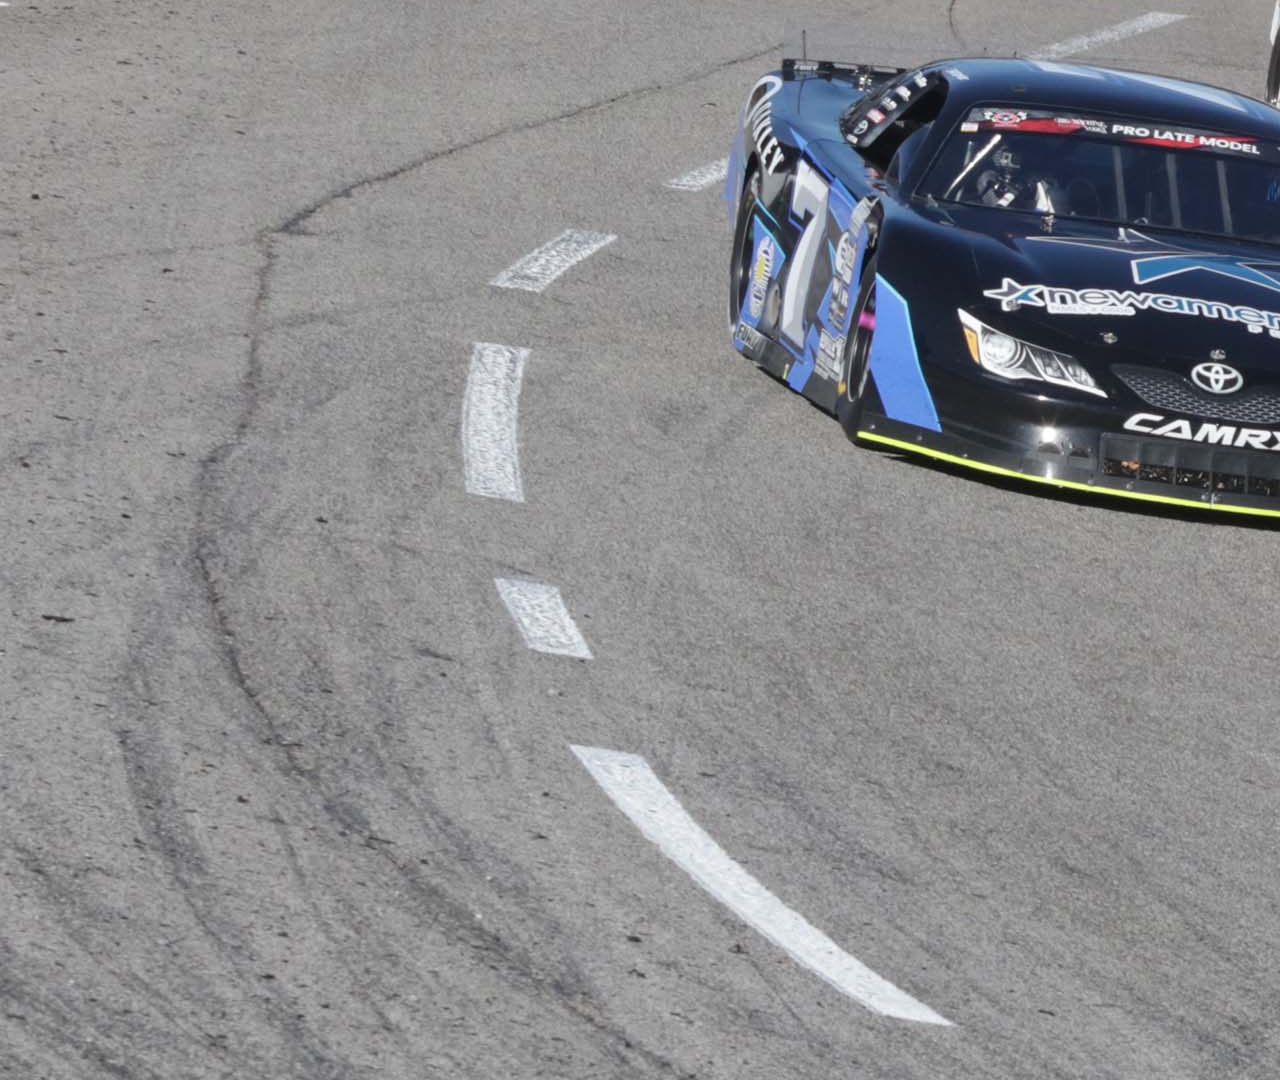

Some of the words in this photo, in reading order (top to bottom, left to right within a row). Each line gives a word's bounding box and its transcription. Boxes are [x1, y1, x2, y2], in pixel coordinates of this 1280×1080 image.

[1112, 123, 1150, 138] PRO
[1153, 127, 1195, 144] LATE
[1199, 134, 1261, 155] MODEL
[789, 158, 833, 353] 7
